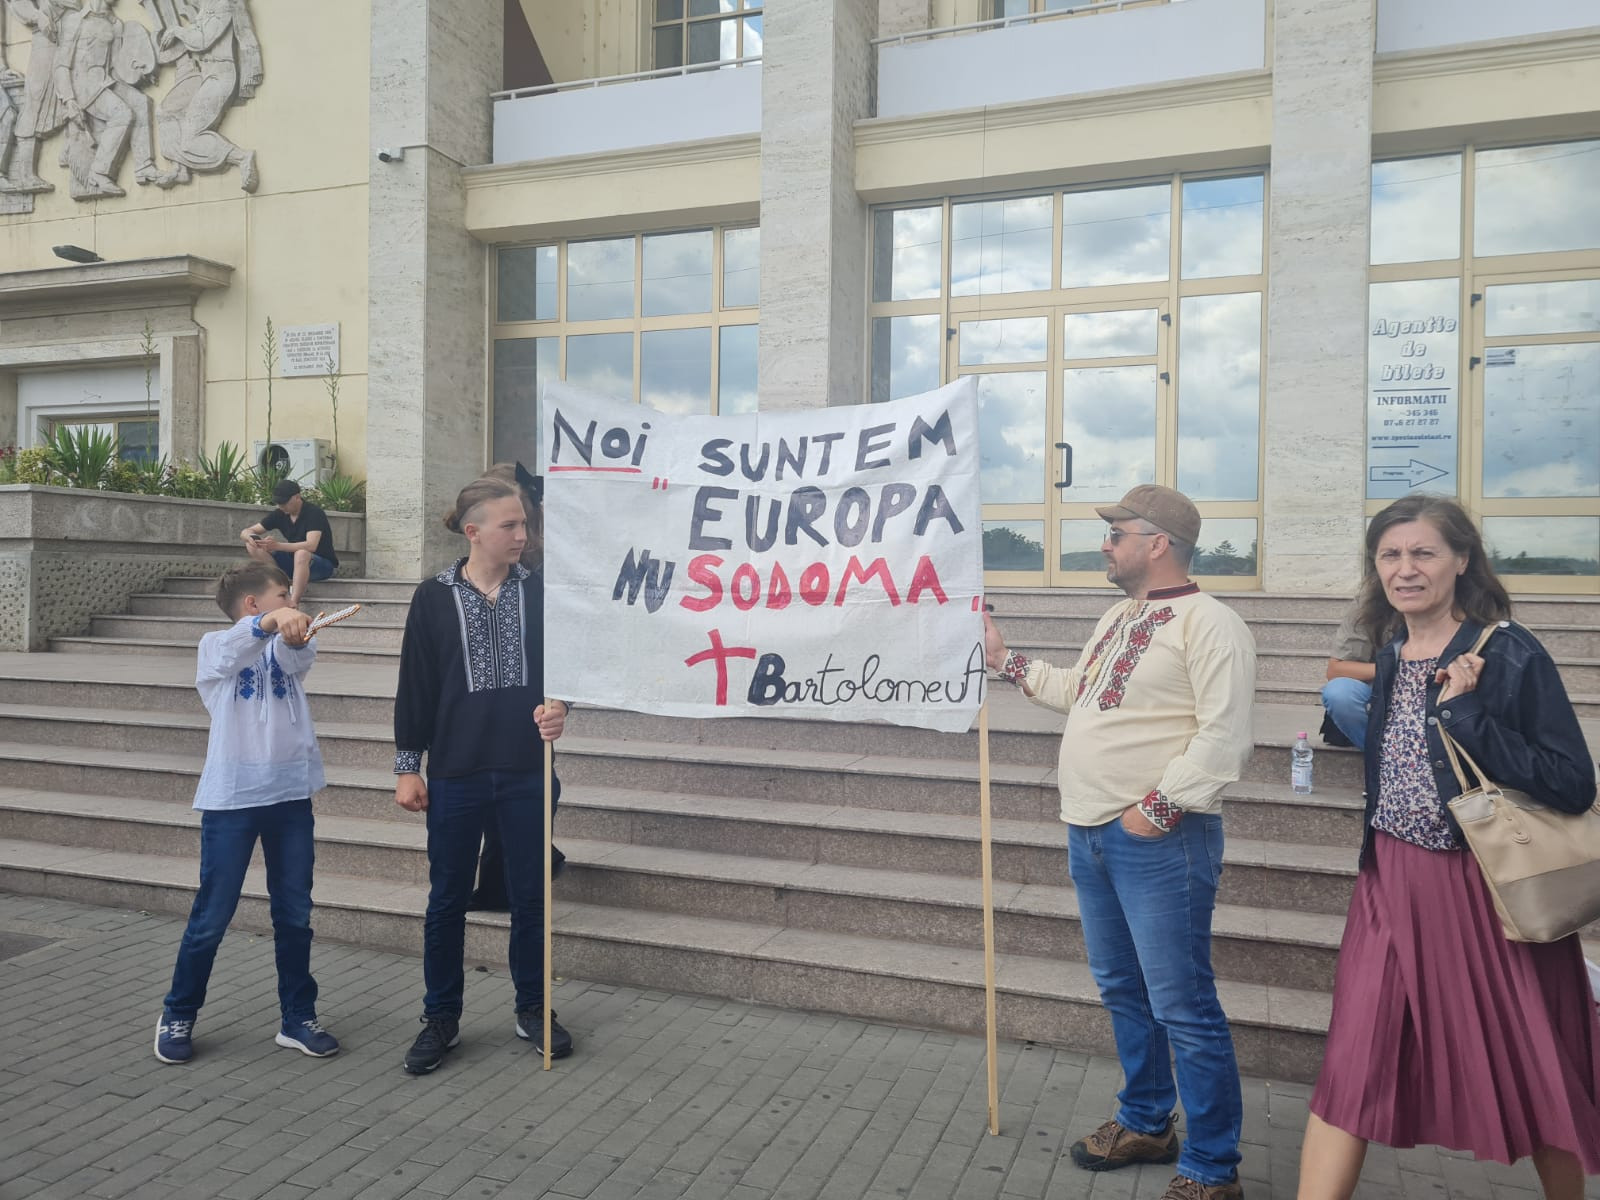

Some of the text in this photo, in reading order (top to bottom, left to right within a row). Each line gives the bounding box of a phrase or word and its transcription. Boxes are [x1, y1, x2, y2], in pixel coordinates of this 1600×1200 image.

[1372, 316, 1456, 338] Agentie
[1400, 340, 1427, 357] de
[1381, 363, 1446, 381] bilete
[1376, 394, 1448, 406] INFORMATII
[551, 408, 957, 482] Noi SUNTEM
[688, 484, 964, 552] EUROPA
[612, 546, 949, 614] NU SODOMA
